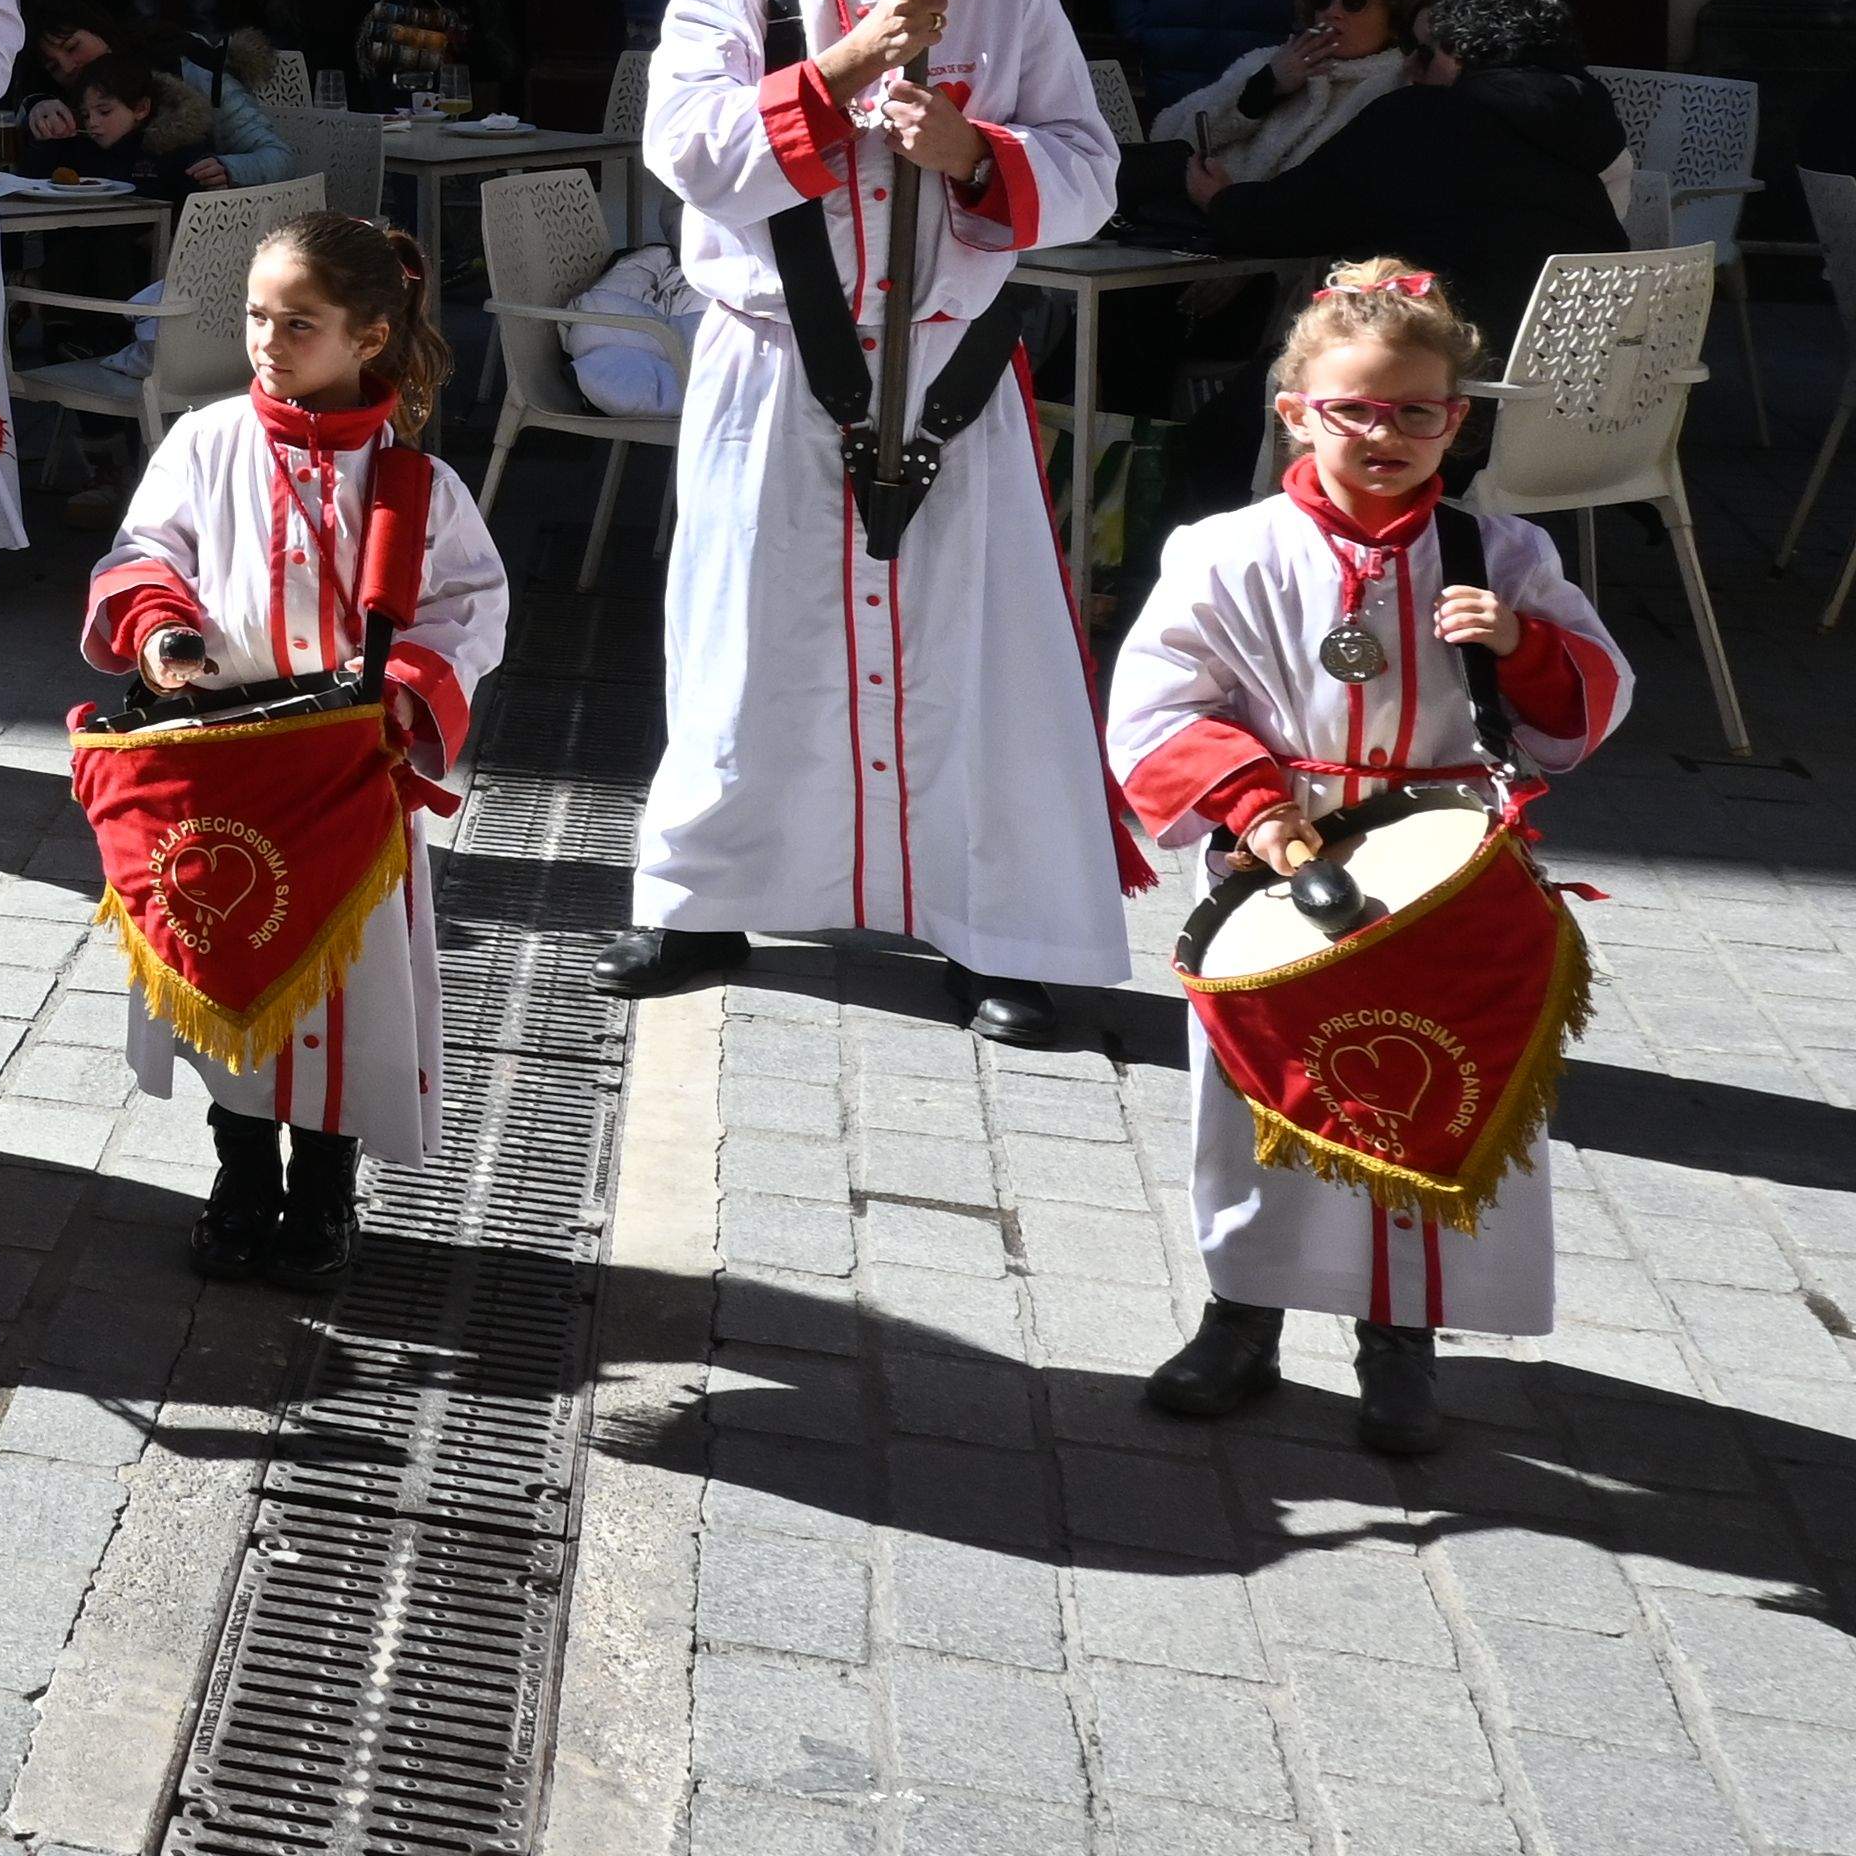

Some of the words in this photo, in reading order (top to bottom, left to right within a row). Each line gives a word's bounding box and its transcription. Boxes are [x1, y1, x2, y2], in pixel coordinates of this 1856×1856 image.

[148, 848, 166, 874] DE
[158, 827, 181, 851] LA
[178, 816, 289, 881] PRECIOSISIMA
[150, 878, 211, 955] COFRADIA
[248, 884, 290, 950] SANGRE
[1304, 1035, 1328, 1058] LA
[1318, 1009, 1467, 1061] PRECIOSISIMA
[1303, 1057, 1324, 1082] DE
[1313, 1085, 1406, 1158] COFRADIA
[1444, 1061, 1481, 1138] SANGRE
